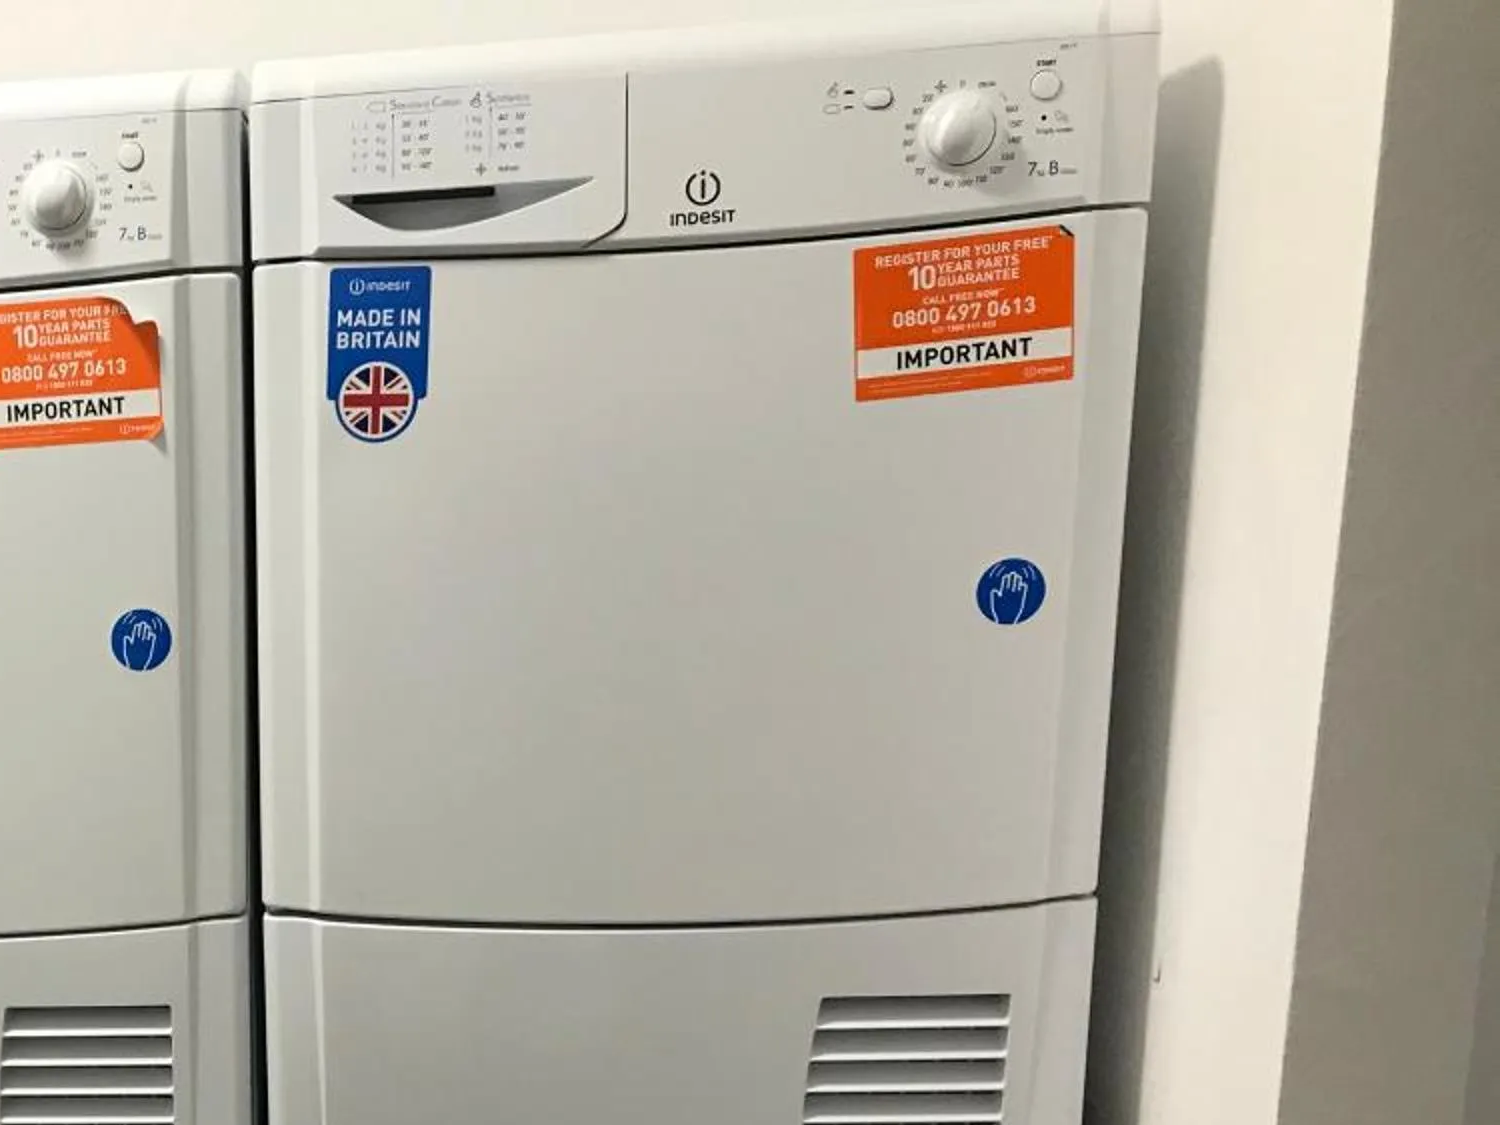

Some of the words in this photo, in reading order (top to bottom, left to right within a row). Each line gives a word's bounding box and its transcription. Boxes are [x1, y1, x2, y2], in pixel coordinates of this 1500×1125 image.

[875, 250, 942, 268] REGISTER
[944, 246, 971, 260] FOR
[974, 242, 1011, 256] YOUR
[908, 265, 936, 290] 10
[937, 259, 973, 274] YEAR
[975, 254, 1020, 269] PARTS
[937, 267, 1021, 287] GUARANTEE
[43, 308, 68, 321] FOR
[69, 305, 102, 319] YOUR
[337, 308, 395, 327] MADE
[400, 308, 421, 326] IN
[892, 307, 940, 329] 0800
[945, 302, 983, 323] 497
[987, 295, 1036, 318] 0613
[13, 325, 39, 349] 10
[39, 320, 70, 333] YEAR
[71, 318, 111, 331] PARTS
[39, 330, 111, 347] GUARANTEE
[336, 330, 421, 350] BRITAIN
[896, 336, 1034, 370] IMPORTANT
[1, 365, 43, 384] 0800
[48, 362, 79, 380] 497
[84, 357, 127, 377] 0613
[6, 396, 125, 423] IMPORTANT
